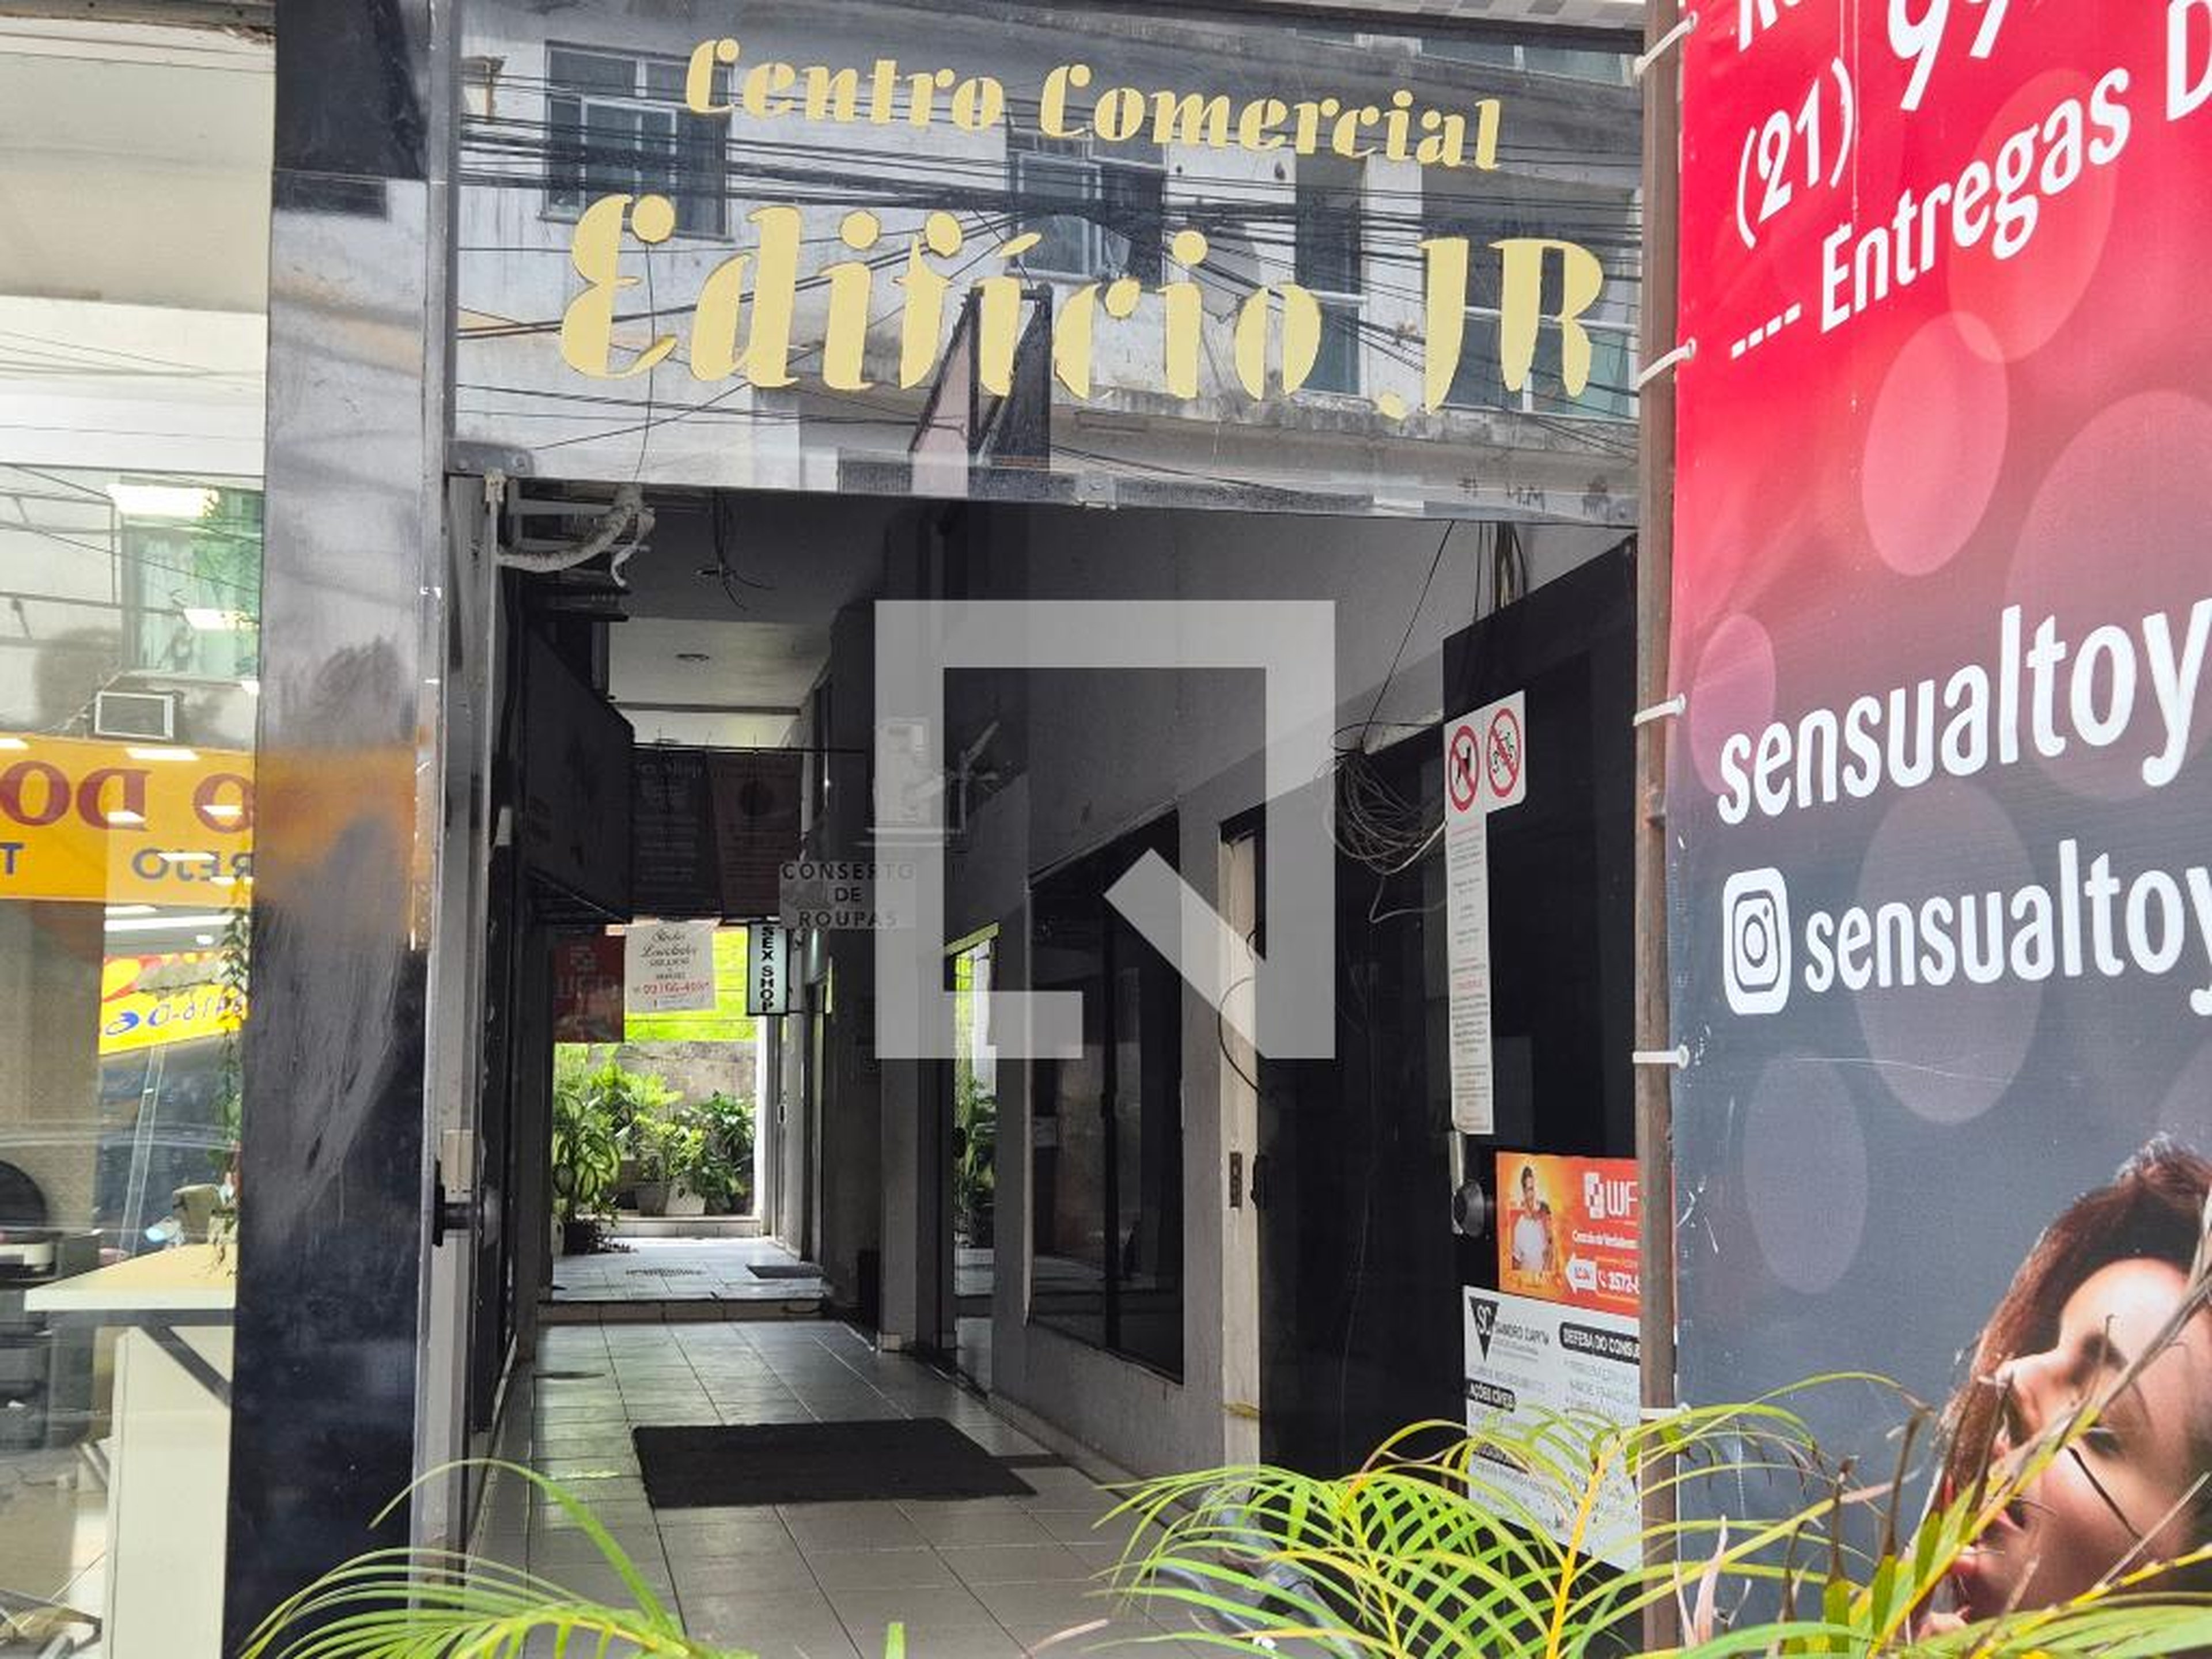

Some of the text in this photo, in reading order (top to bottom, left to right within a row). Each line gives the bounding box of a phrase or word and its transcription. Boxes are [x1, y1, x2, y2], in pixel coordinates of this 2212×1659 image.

[686, 38, 1502, 171] Centro Comercial
[1737, 57, 1854, 249] (21)
[1821, 67, 2131, 334] Entregas
[560, 194, 1604, 421] Edifício JR
[1718, 597, 2212, 824] sensualtoy
[782, 863, 914, 880] CONSERTO
[798, 910, 897, 927] ROUPAS
[835, 887, 863, 902] DE
[760, 926, 775, 1012] SEX SHOP
